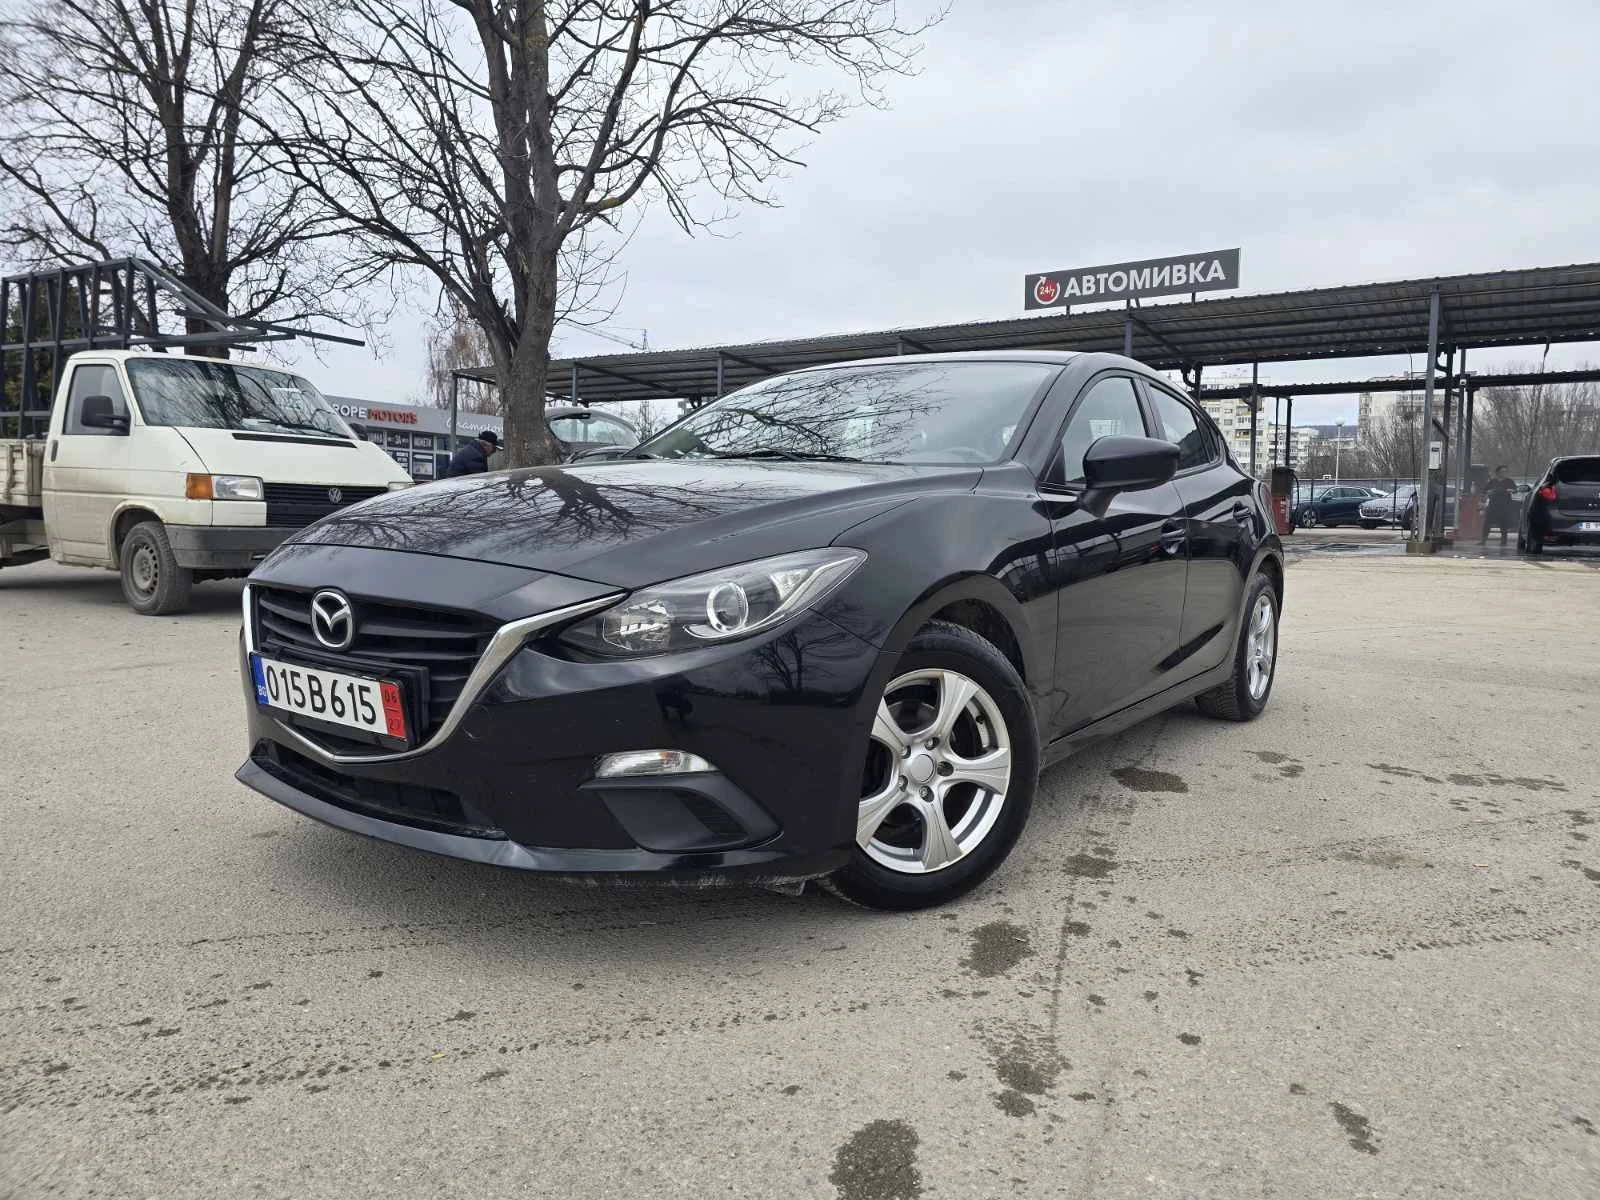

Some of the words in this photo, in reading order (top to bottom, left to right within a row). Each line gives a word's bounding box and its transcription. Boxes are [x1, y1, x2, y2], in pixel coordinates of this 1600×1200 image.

[1064, 259, 1226, 298] АВТОМИВКА
[1040, 285, 1055, 297] 24/7
[258, 685, 267, 696] BG
